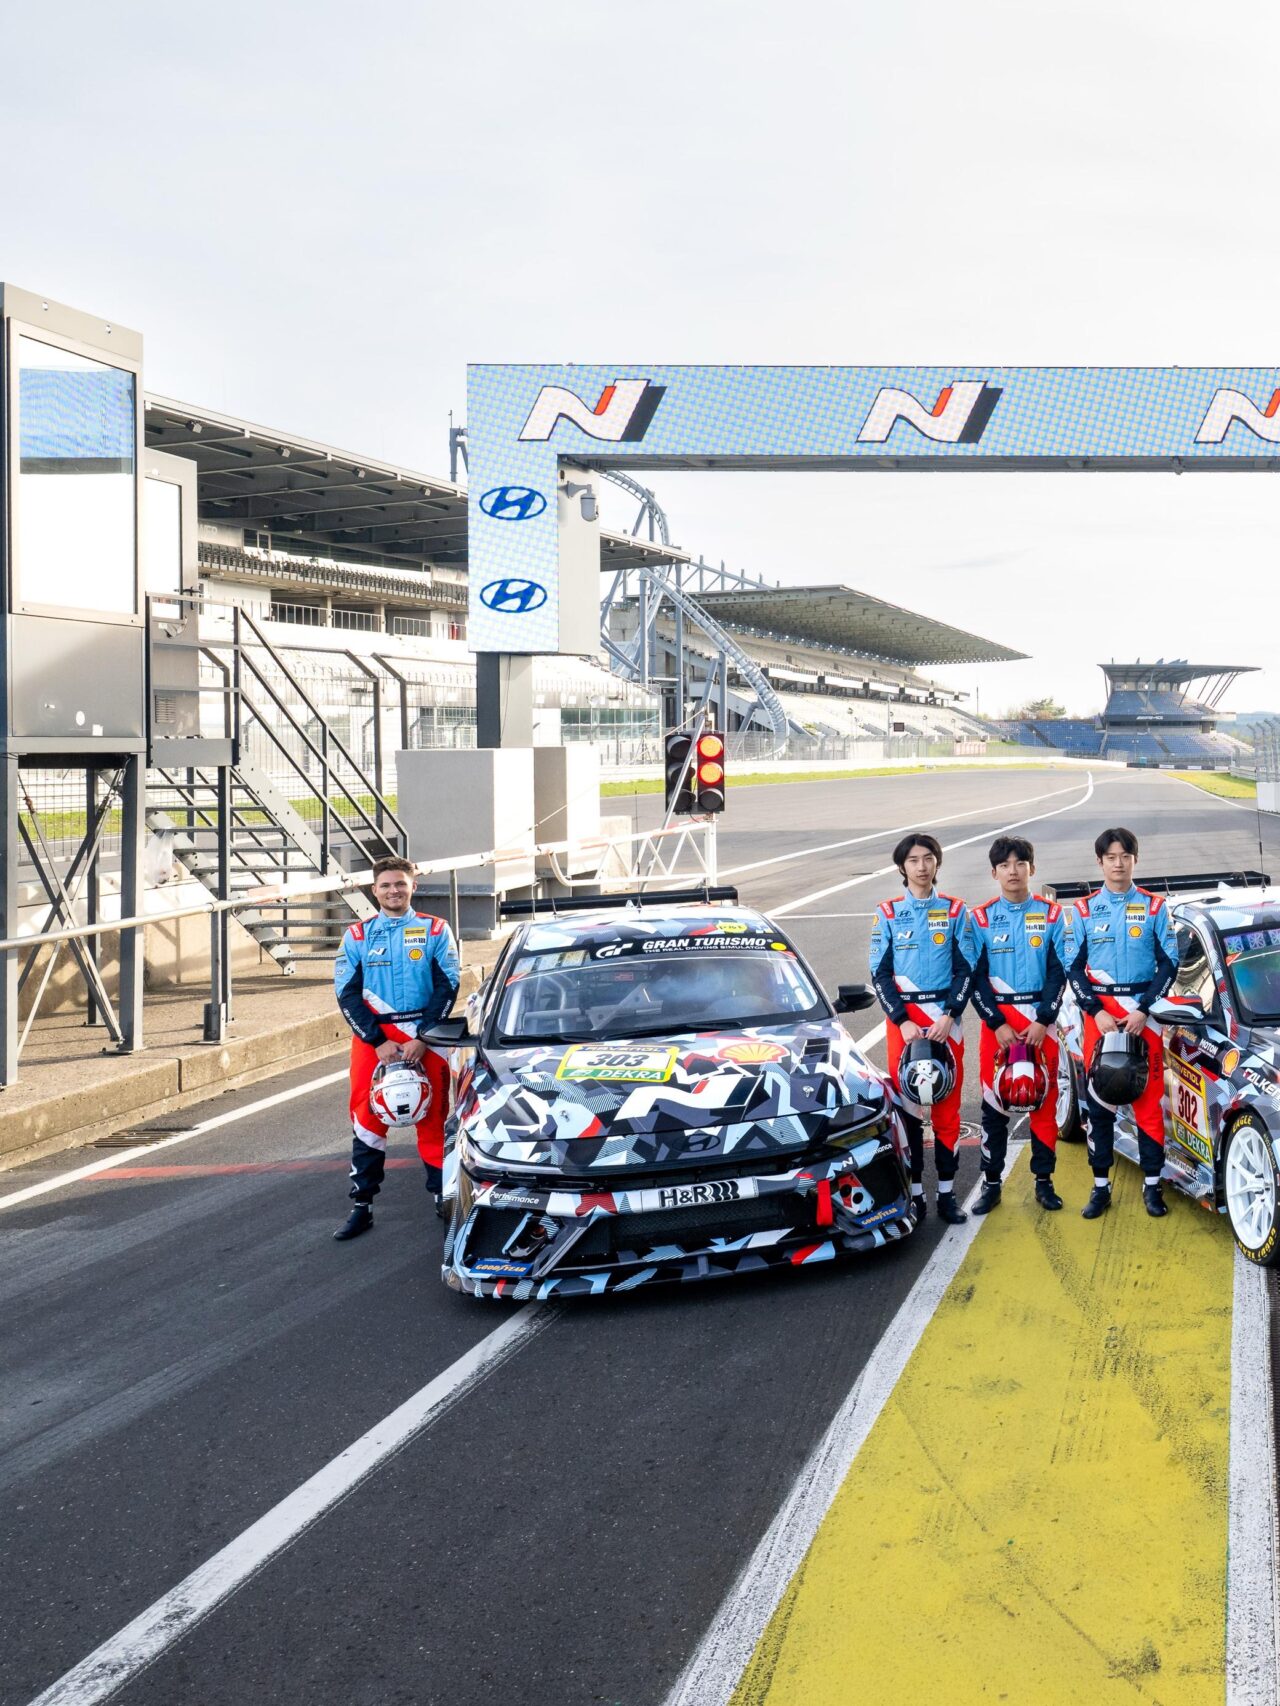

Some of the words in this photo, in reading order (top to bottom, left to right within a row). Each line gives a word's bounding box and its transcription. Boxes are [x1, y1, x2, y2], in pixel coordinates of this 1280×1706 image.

[642, 938, 690, 950] GRAN
[694, 937, 767, 947] TURISMO
[587, 1053, 650, 1067] 303
[599, 1069, 662, 1081] DEKRA
[1178, 1085, 1198, 1130] 302
[1232, 1115, 1253, 1133] EAGLE
[1187, 1129, 1211, 1160] DEKRA
[490, 1191, 540, 1205] Performance
[659, 1185, 709, 1208] H&R
[475, 1263, 528, 1274] GOODYEAR
